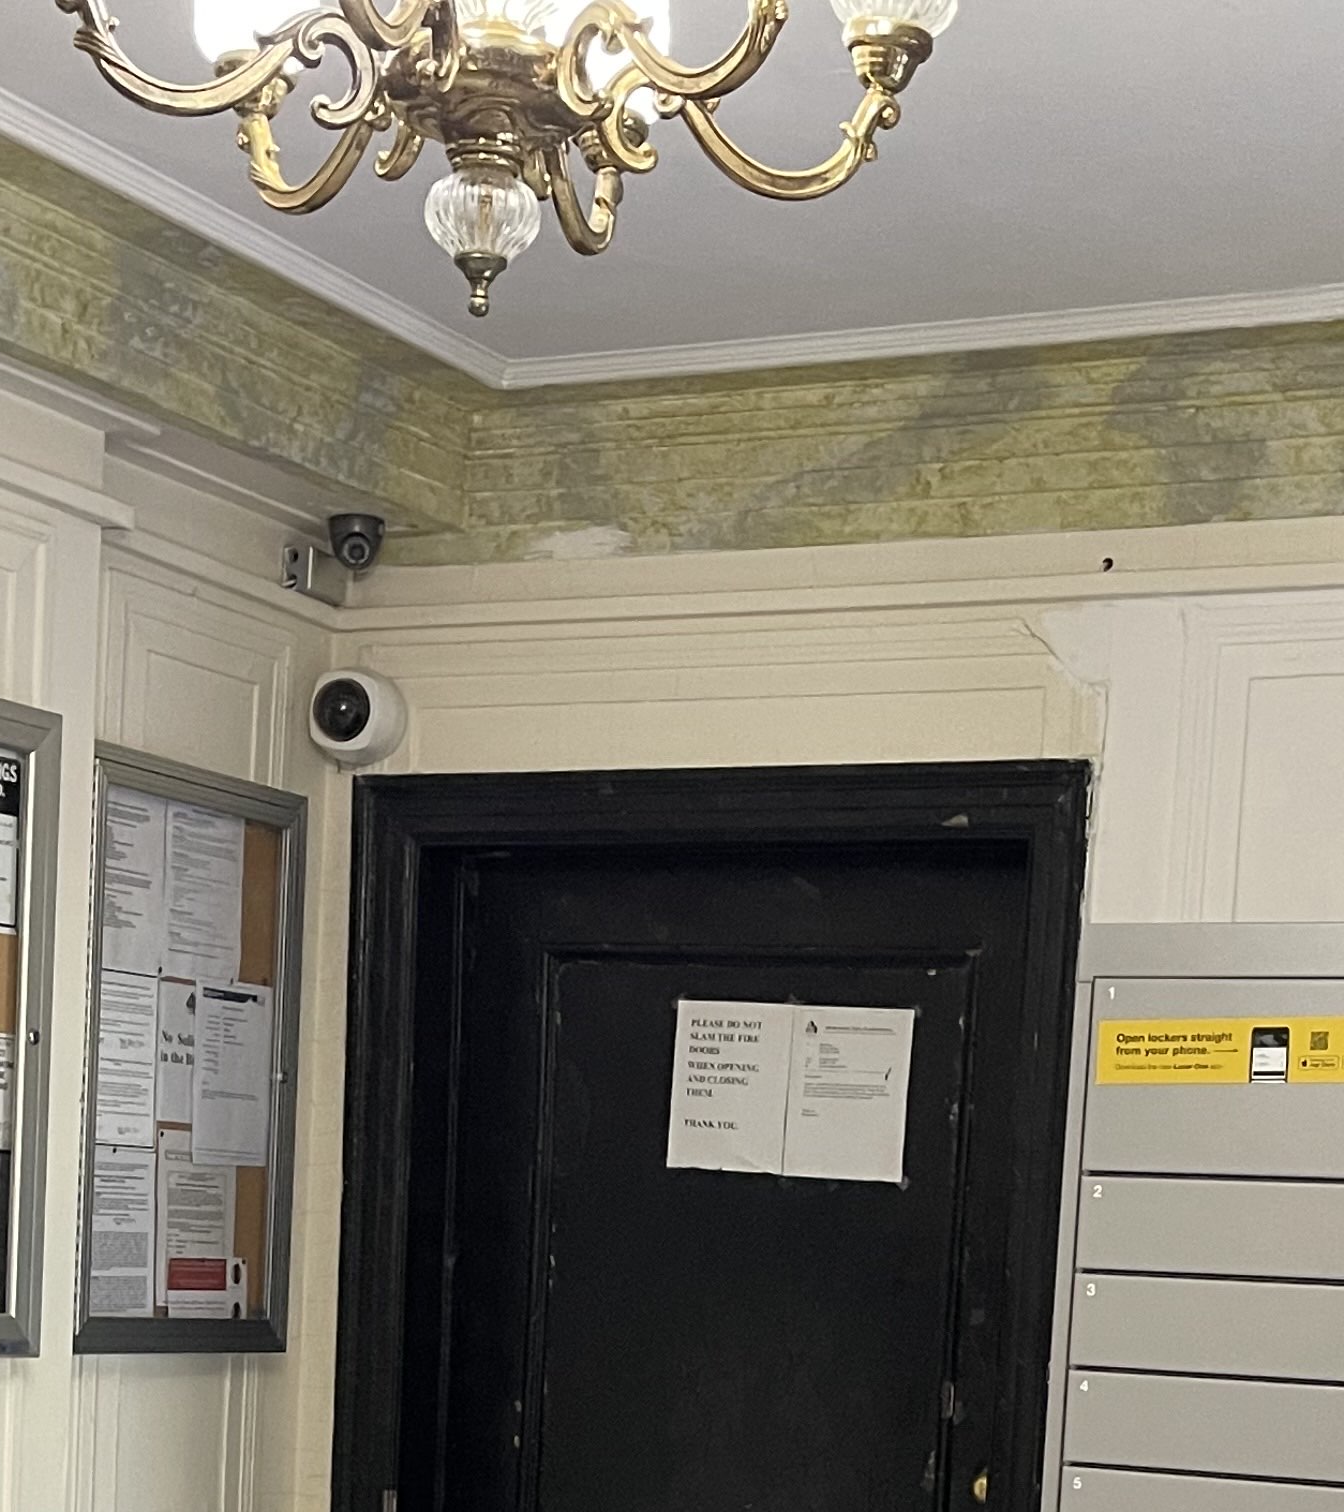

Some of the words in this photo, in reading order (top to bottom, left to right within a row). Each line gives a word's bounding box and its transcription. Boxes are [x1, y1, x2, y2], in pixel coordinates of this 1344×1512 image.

[1108, 986, 1115, 1000] 1
[691, 1018, 724, 1028] PLEASE
[726, 1020, 740, 1029] DO
[743, 1020, 762, 1030] NOT
[690, 1032, 716, 1040] SLAM
[718, 1033, 735, 1042] THE
[738, 1034, 759, 1043] FIRE
[1116, 1033, 1145, 1044] Open
[1148, 1032, 1187, 1042] lockers
[1191, 1032, 1232, 1044] straight
[1116, 1046, 1141, 1055] from
[1144, 1048, 1169, 1056] your
[1172, 1046, 1211, 1056] phone.
[688, 1061, 715, 1070] WHEN
[717, 1063, 760, 1072] OPENING
[688, 1074, 706, 1083] AND
[707, 1076, 749, 1086] CLOSING
[684, 1119, 715, 1128] THANK
[1092, 1184, 1103, 1198] 2
[1086, 1283, 1096, 1297] 3
[1079, 1379, 1089, 1392] 4
[1072, 1476, 1083, 1490] 5
